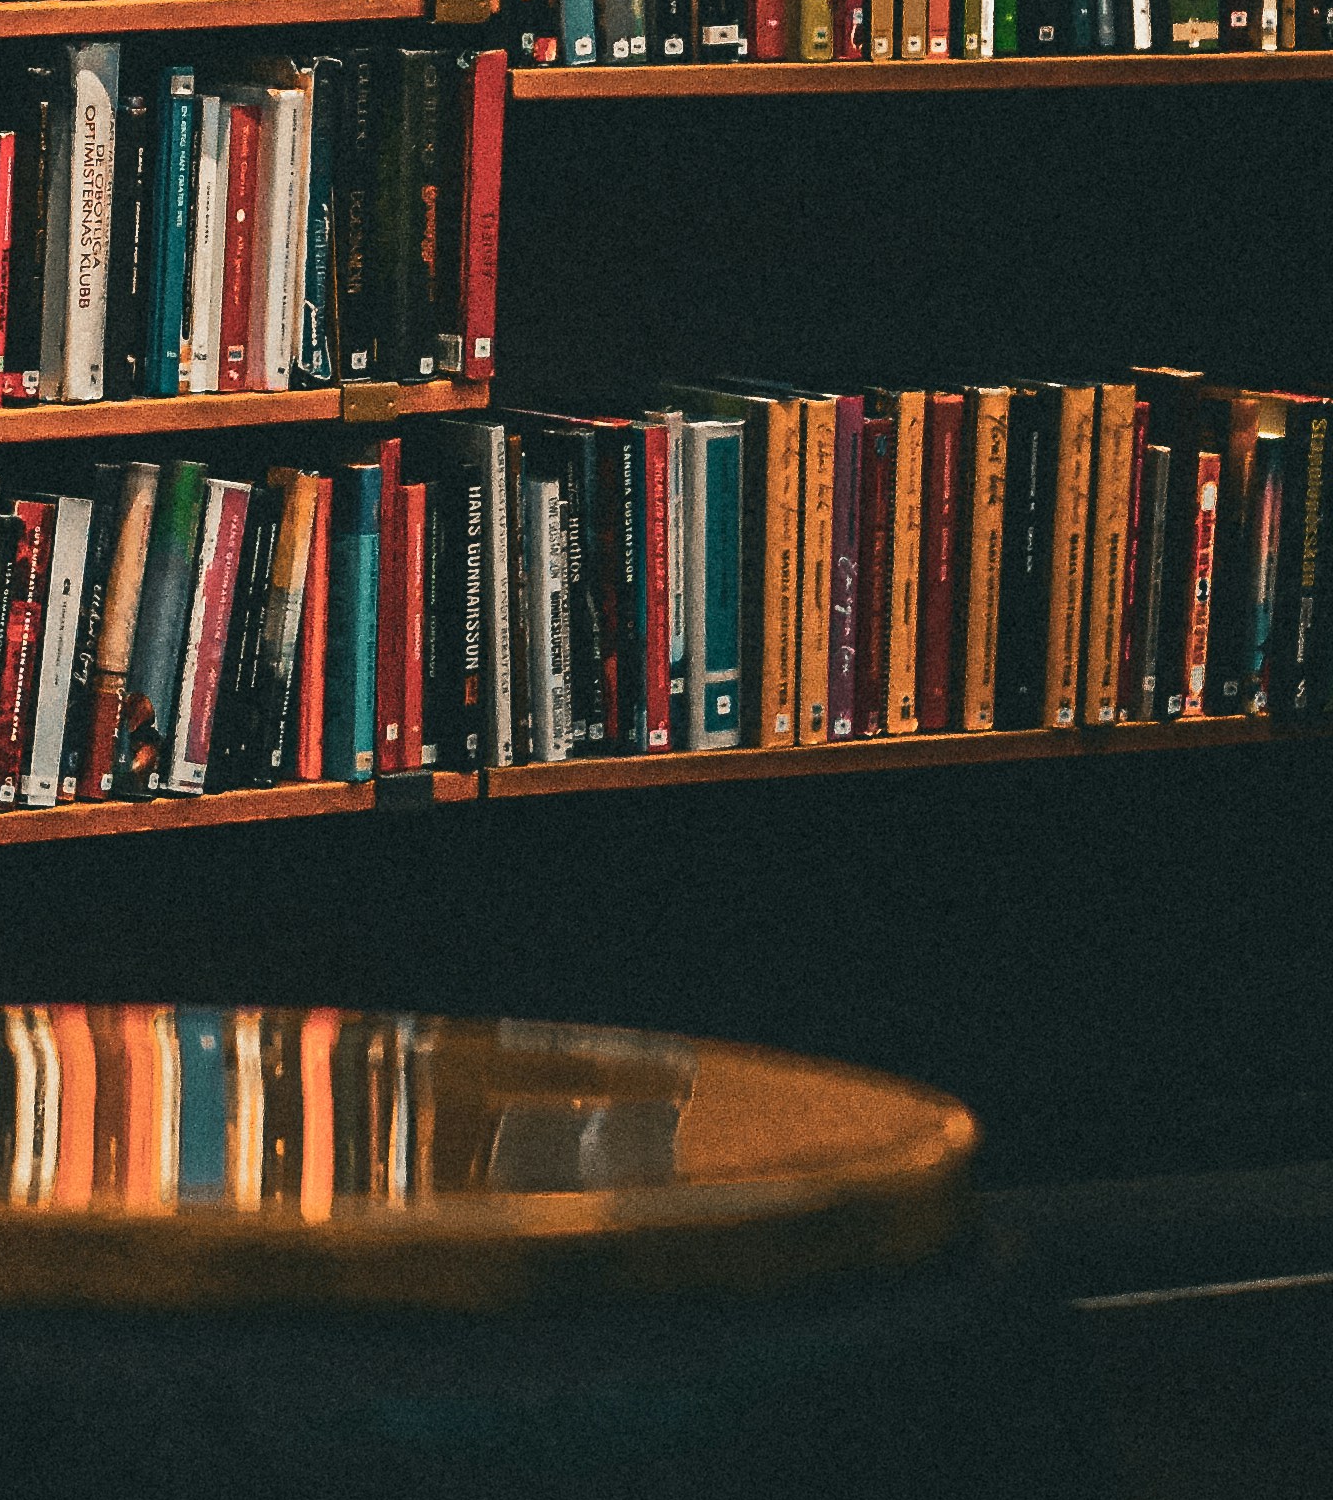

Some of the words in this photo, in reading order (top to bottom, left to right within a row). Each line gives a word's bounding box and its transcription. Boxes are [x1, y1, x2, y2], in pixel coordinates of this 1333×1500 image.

[80, 105, 96, 246] OPTIMISTERNAS
[92, 172, 103, 268] OBOTLIGA
[78, 254, 91, 309] KLUBB
